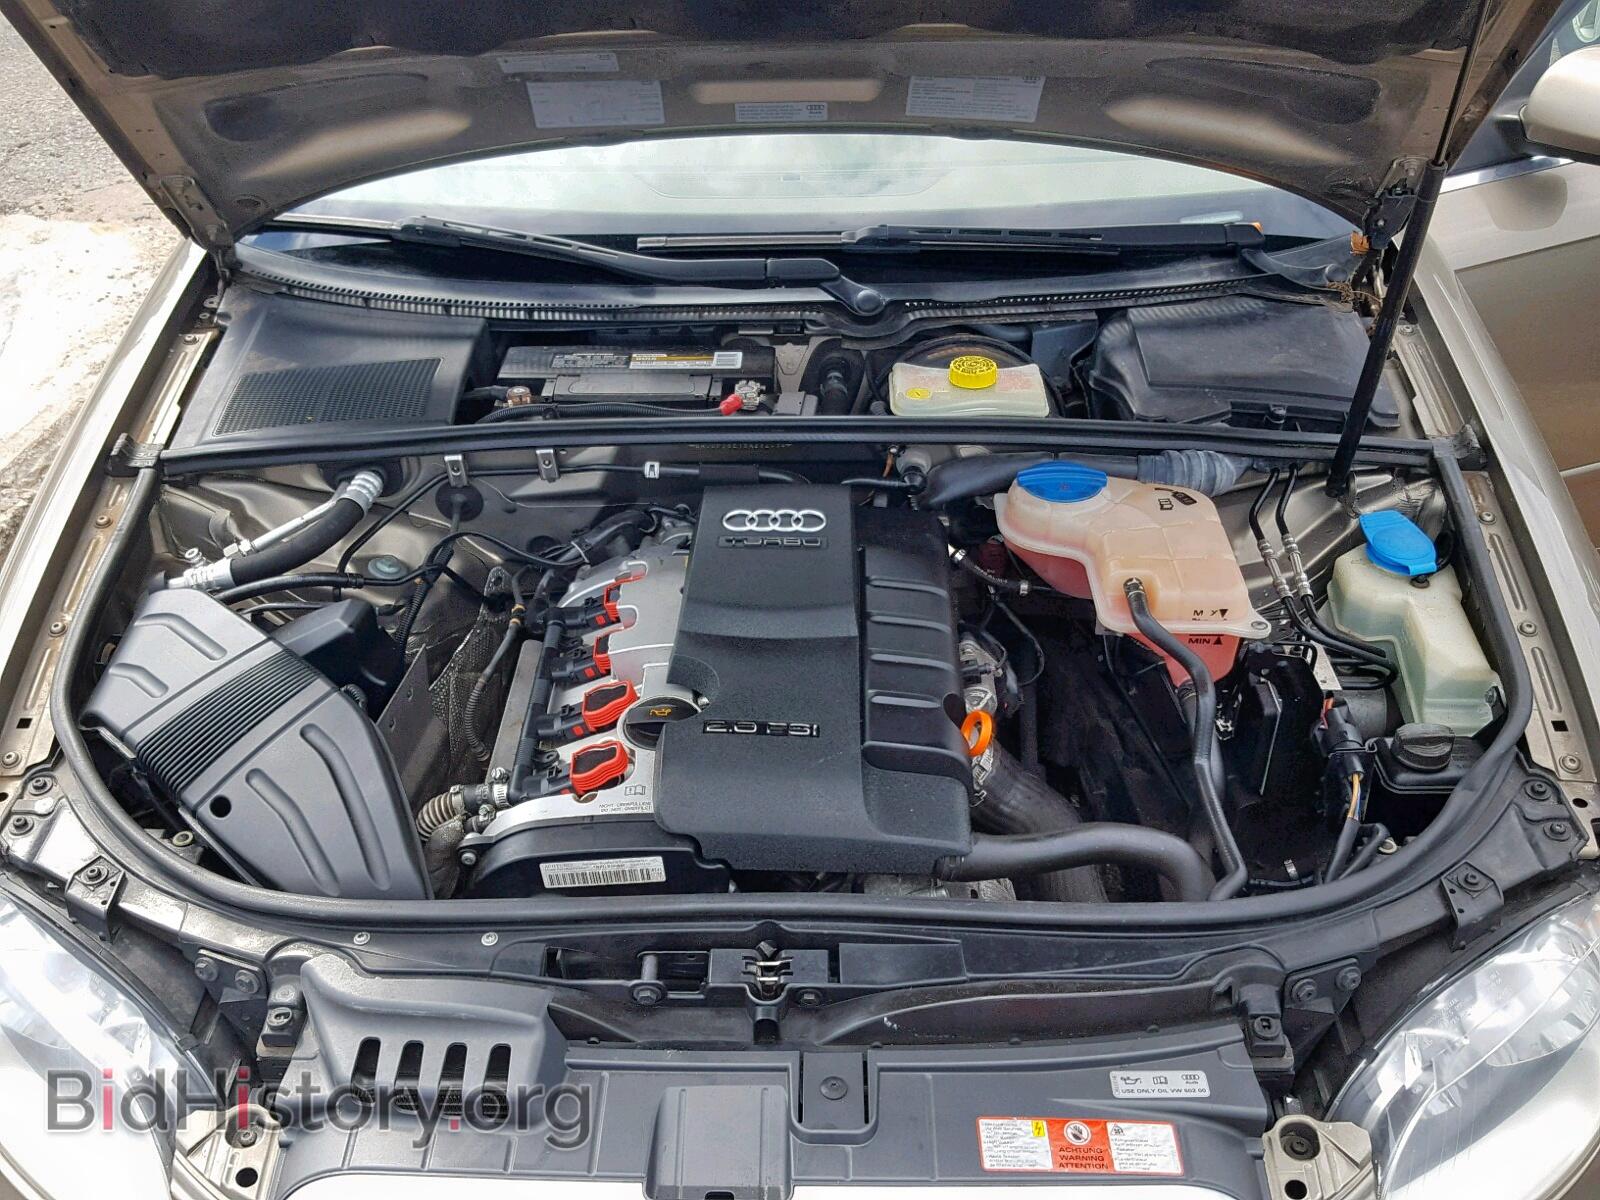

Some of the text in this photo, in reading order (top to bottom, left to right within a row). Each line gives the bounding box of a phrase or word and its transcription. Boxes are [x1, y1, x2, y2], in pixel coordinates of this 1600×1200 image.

[724, 536, 821, 546] TURBO
[1193, 609, 1218, 617] MX
[1188, 637, 1211, 645] MIN
[706, 720, 817, 736] 2.0 FSI
[1058, 1162, 1109, 1170] ATTENTION
